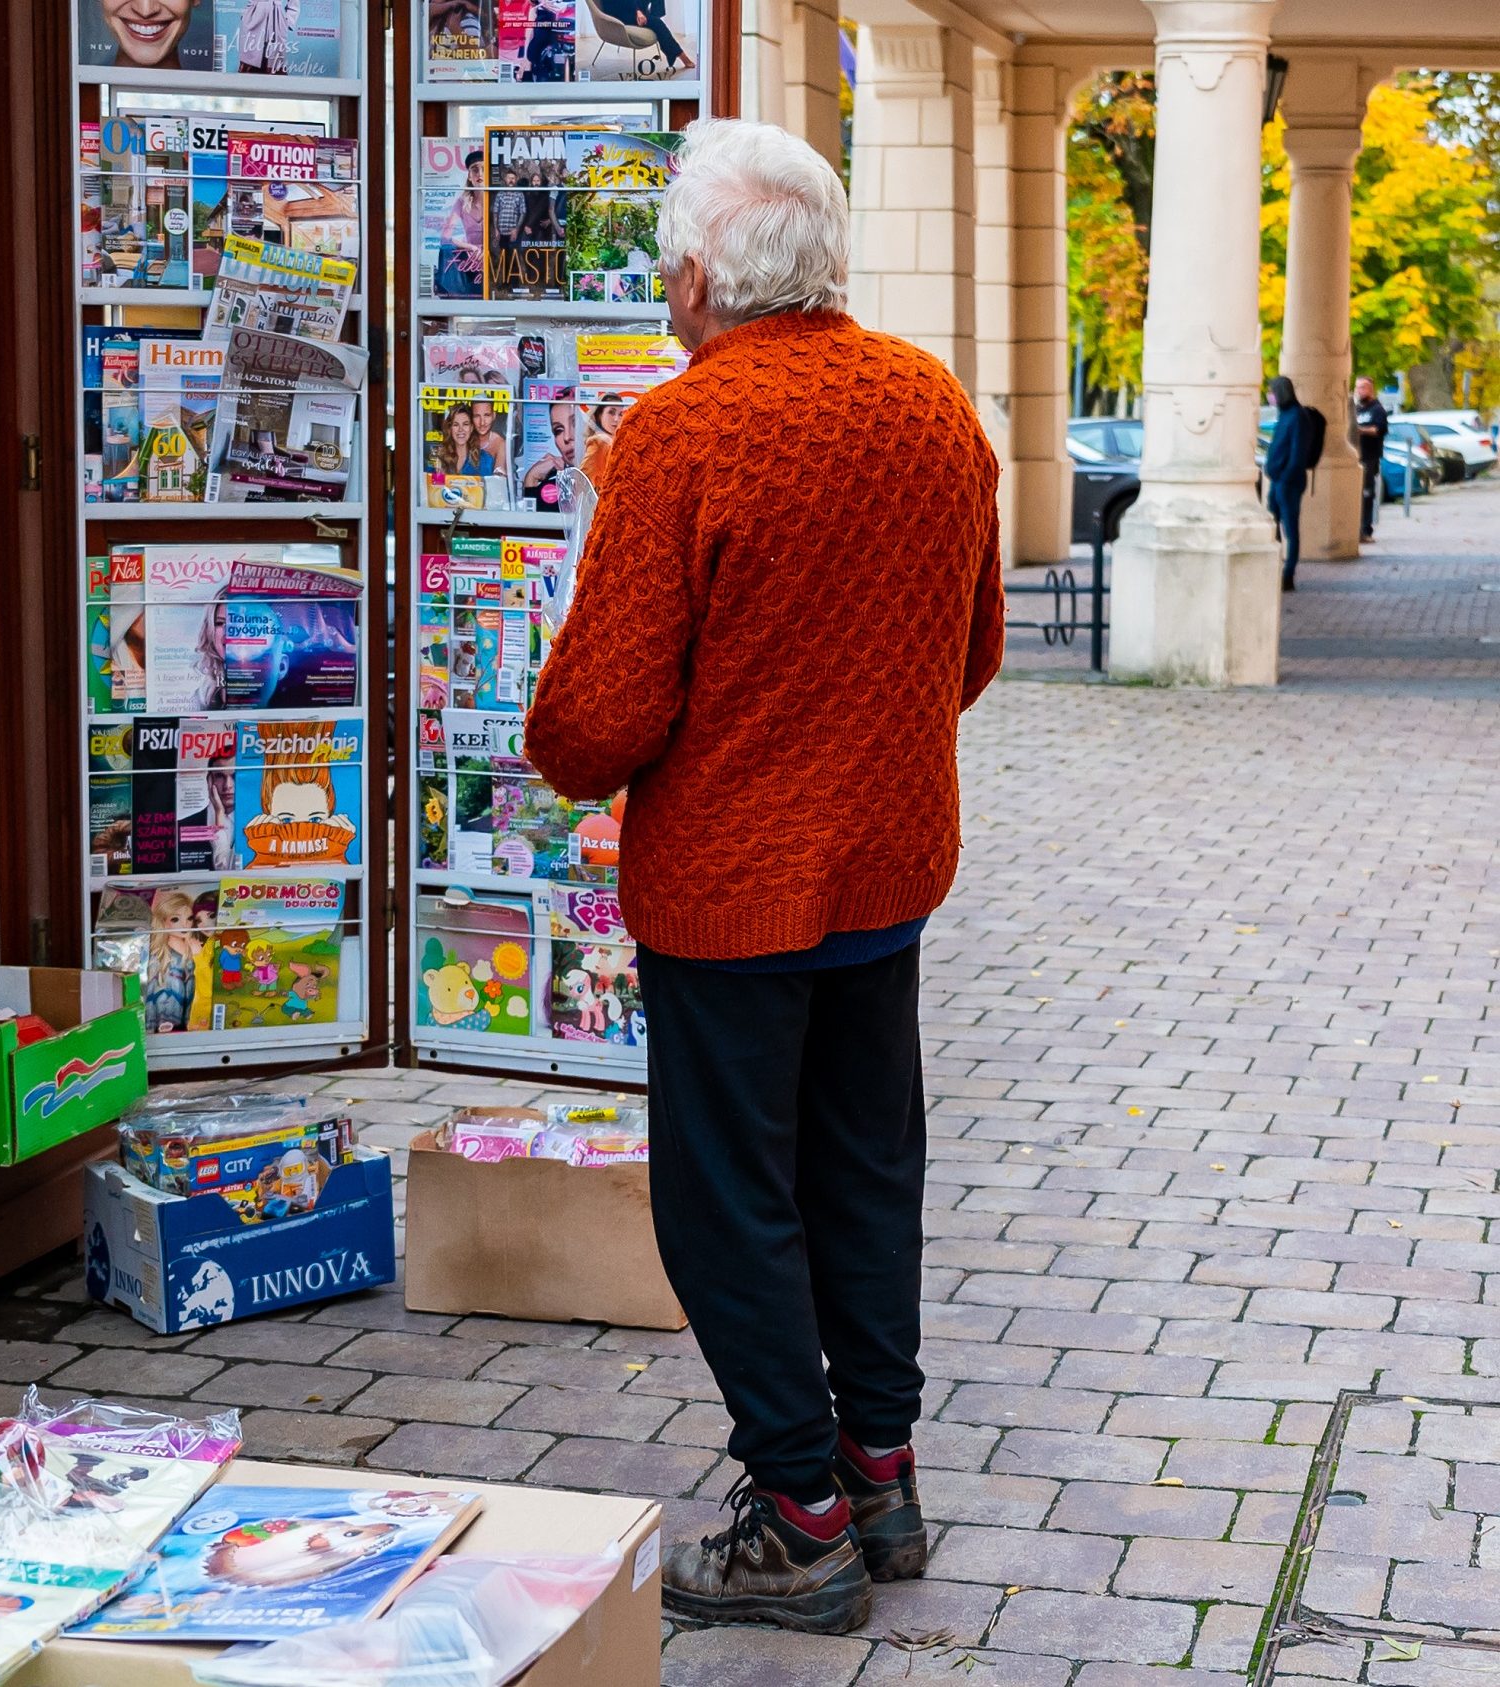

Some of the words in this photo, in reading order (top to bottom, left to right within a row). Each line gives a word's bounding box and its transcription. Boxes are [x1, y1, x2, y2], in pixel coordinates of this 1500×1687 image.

[90, 43, 113, 51] NEW
[183, 48, 210, 57] HOPE
[250, 144, 315, 166] OTTHON
[266, 163, 314, 180] KERT
[151, 344, 223, 367] Harm
[581, 349, 610, 357] JOY
[152, 431, 187, 458] 60
[526, 550, 558, 560] AJÁNDÉK
[230, 577, 259, 589] NEM
[261, 579, 307, 591] MINDIG
[228, 612, 272, 624] Trauma-
[241, 732, 359, 754] Pszichológia
[269, 839, 277, 852] A
[281, 837, 328, 854] KAMASZ
[582, 837, 598, 849] Az
[197, 1164, 219, 1177] LEGO
[224, 1157, 253, 1174] CITY
[251, 1250, 373, 1305] INNOVA
